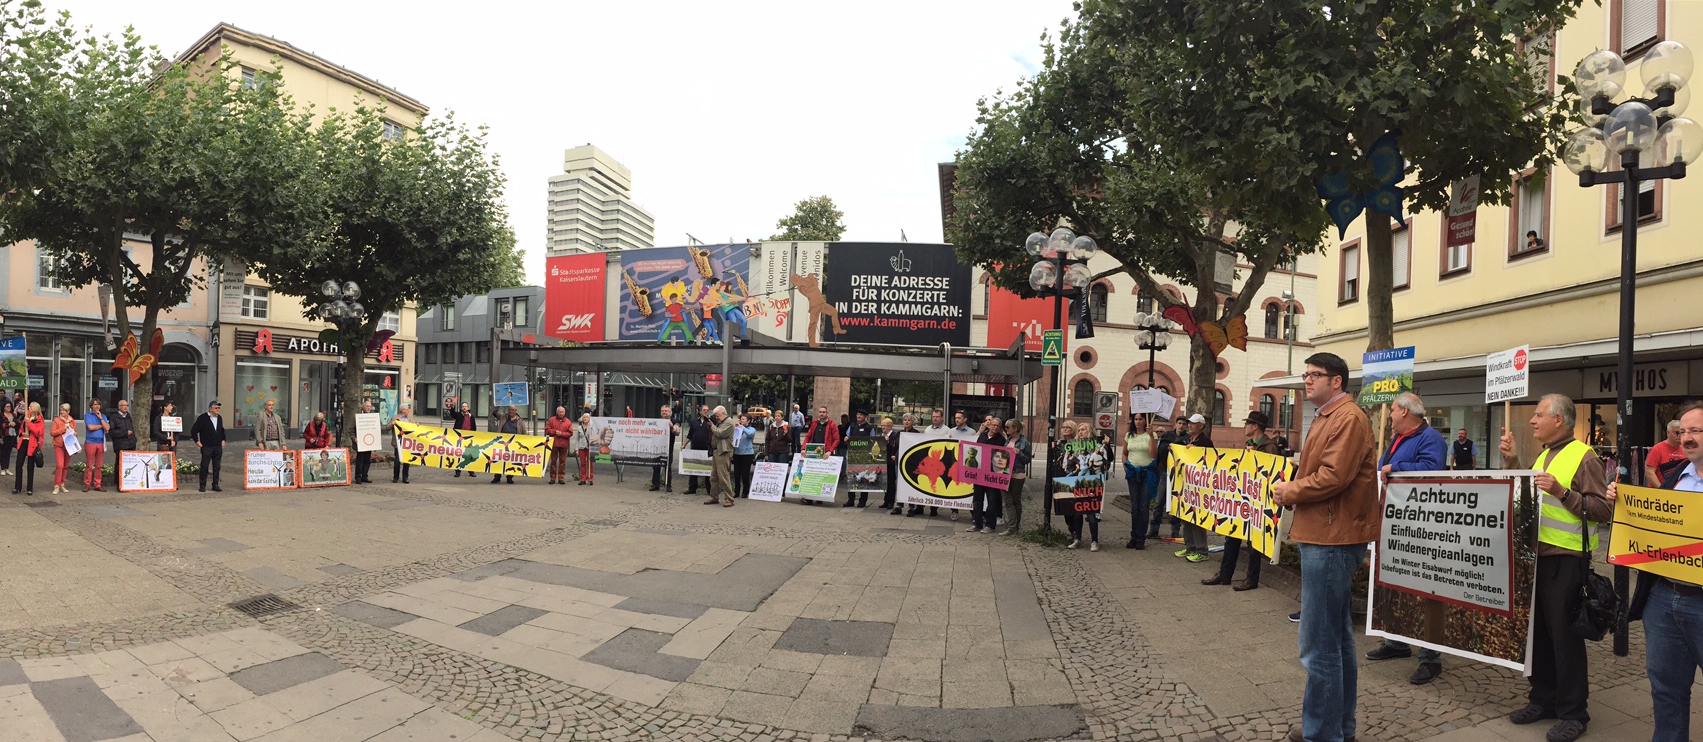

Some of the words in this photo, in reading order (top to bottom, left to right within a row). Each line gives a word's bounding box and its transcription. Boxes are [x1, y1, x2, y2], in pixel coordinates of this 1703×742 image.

[1450, 217, 1474, 230] Gesund
[1455, 226, 1475, 239] schön!
[559, 267, 600, 276] Stadtsparkasse
[779, 250, 788, 287] Welcome
[559, 275, 598, 283] Kaiserslautern
[851, 275, 888, 288] DEINE
[891, 275, 950, 290] ADRESSE
[852, 286, 877, 300] FÜR
[881, 289, 947, 303] KONZERTE
[835, 301, 848, 314] IN
[852, 302, 877, 314] DER
[880, 303, 963, 318] KAMMGARN:
[557, 313, 596, 330] SWK
[840, 315, 957, 331] www.kammgarn.de
[1368, 349, 1408, 361] INITIATIVE
[1488, 359, 1513, 373] Windkraft
[1514, 354, 1527, 366] STOP
[1373, 379, 1399, 394] PRO
[1487, 379, 1495, 387] im
[1494, 370, 1526, 386] Pfälzerwald
[1599, 368, 1667, 392] MHOS
[1487, 391, 1500, 401] NEIN
[1500, 386, 1525, 399] DANKE!!!
[402, 437, 425, 452] Die
[428, 444, 464, 457] neue
[491, 448, 542, 465] Heimat
[1064, 438, 1098, 453] GRÜN!
[984, 474, 998, 484] Nicht
[1184, 464, 1210, 489] Nicht
[1212, 469, 1237, 493] alles
[1073, 486, 1104, 498] NICH
[1183, 485, 1201, 507] sich
[1406, 487, 1479, 509] Achtung
[908, 496, 925, 504] Jährlich
[943, 499, 953, 507] tote
[1074, 500, 1103, 512] GRÜ
[1623, 493, 1684, 516] Windräder
[1384, 503, 1505, 529] Gefahrenzone!
[1626, 509, 1637, 518] 1km
[1637, 511, 1684, 526] Mindestabstand
[1390, 524, 1461, 544] Einflußbereich
[1468, 535, 1491, 548] von
[1387, 538, 1494, 567] Windenergieanlagen
[1392, 556, 1400, 565] Im
[1400, 557, 1421, 569] Winter
[1422, 560, 1453, 575] Eisabwurf
[1454, 567, 1485, 582] möglich!
[1381, 563, 1411, 577] Unbefugten
[1411, 569, 1421, 578] ist
[1421, 571, 1432, 581] das
[1433, 573, 1465, 587] Betreten
[1466, 579, 1505, 595] verboten.
[1463, 591, 1475, 600] Der
[1475, 594, 1506, 607] Betreiber
